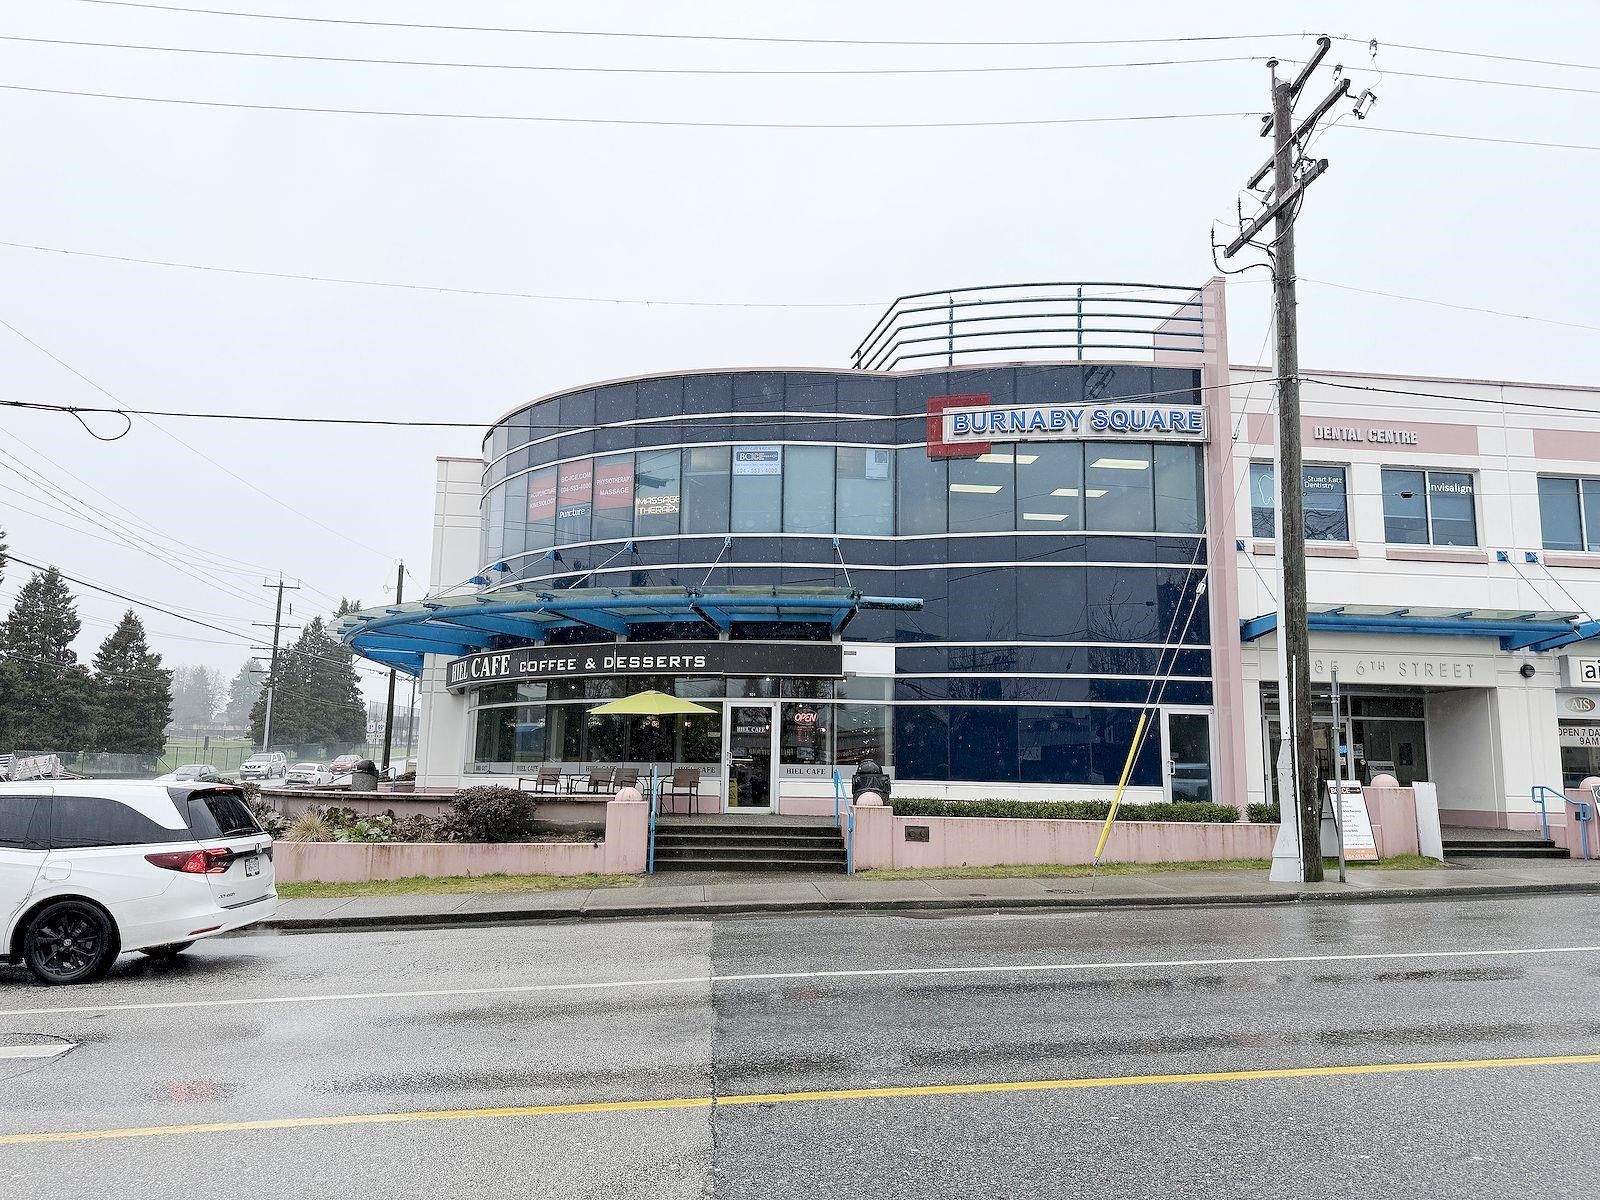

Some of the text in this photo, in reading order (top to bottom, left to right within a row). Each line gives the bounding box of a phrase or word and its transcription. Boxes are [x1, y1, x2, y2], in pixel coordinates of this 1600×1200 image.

[952, 409, 1203, 434] BURNABY SQUARE
[1314, 425, 1418, 444] DENTAL CENTRE
[1328, 476, 1343, 484] Katz
[1304, 481, 1334, 491] Dentistry
[1428, 482, 1473, 494] Invisalign
[600, 487, 630, 496] MASSAGE
[636, 496, 680, 505] MASSAGE
[638, 505, 680, 515] THERAPY
[451, 654, 706, 683] HIEL CAFE COFFEE & DESSERTS
[1399, 662, 1474, 679] STREET
[1570, 698, 1591, 711] AIS
[794, 712, 817, 723] OPEN
[751, 726, 766, 734] CAFE
[1581, 728, 1586, 738] 7
[1588, 728, 1600, 738] DA
[1579, 737, 1600, 746] 9AM
